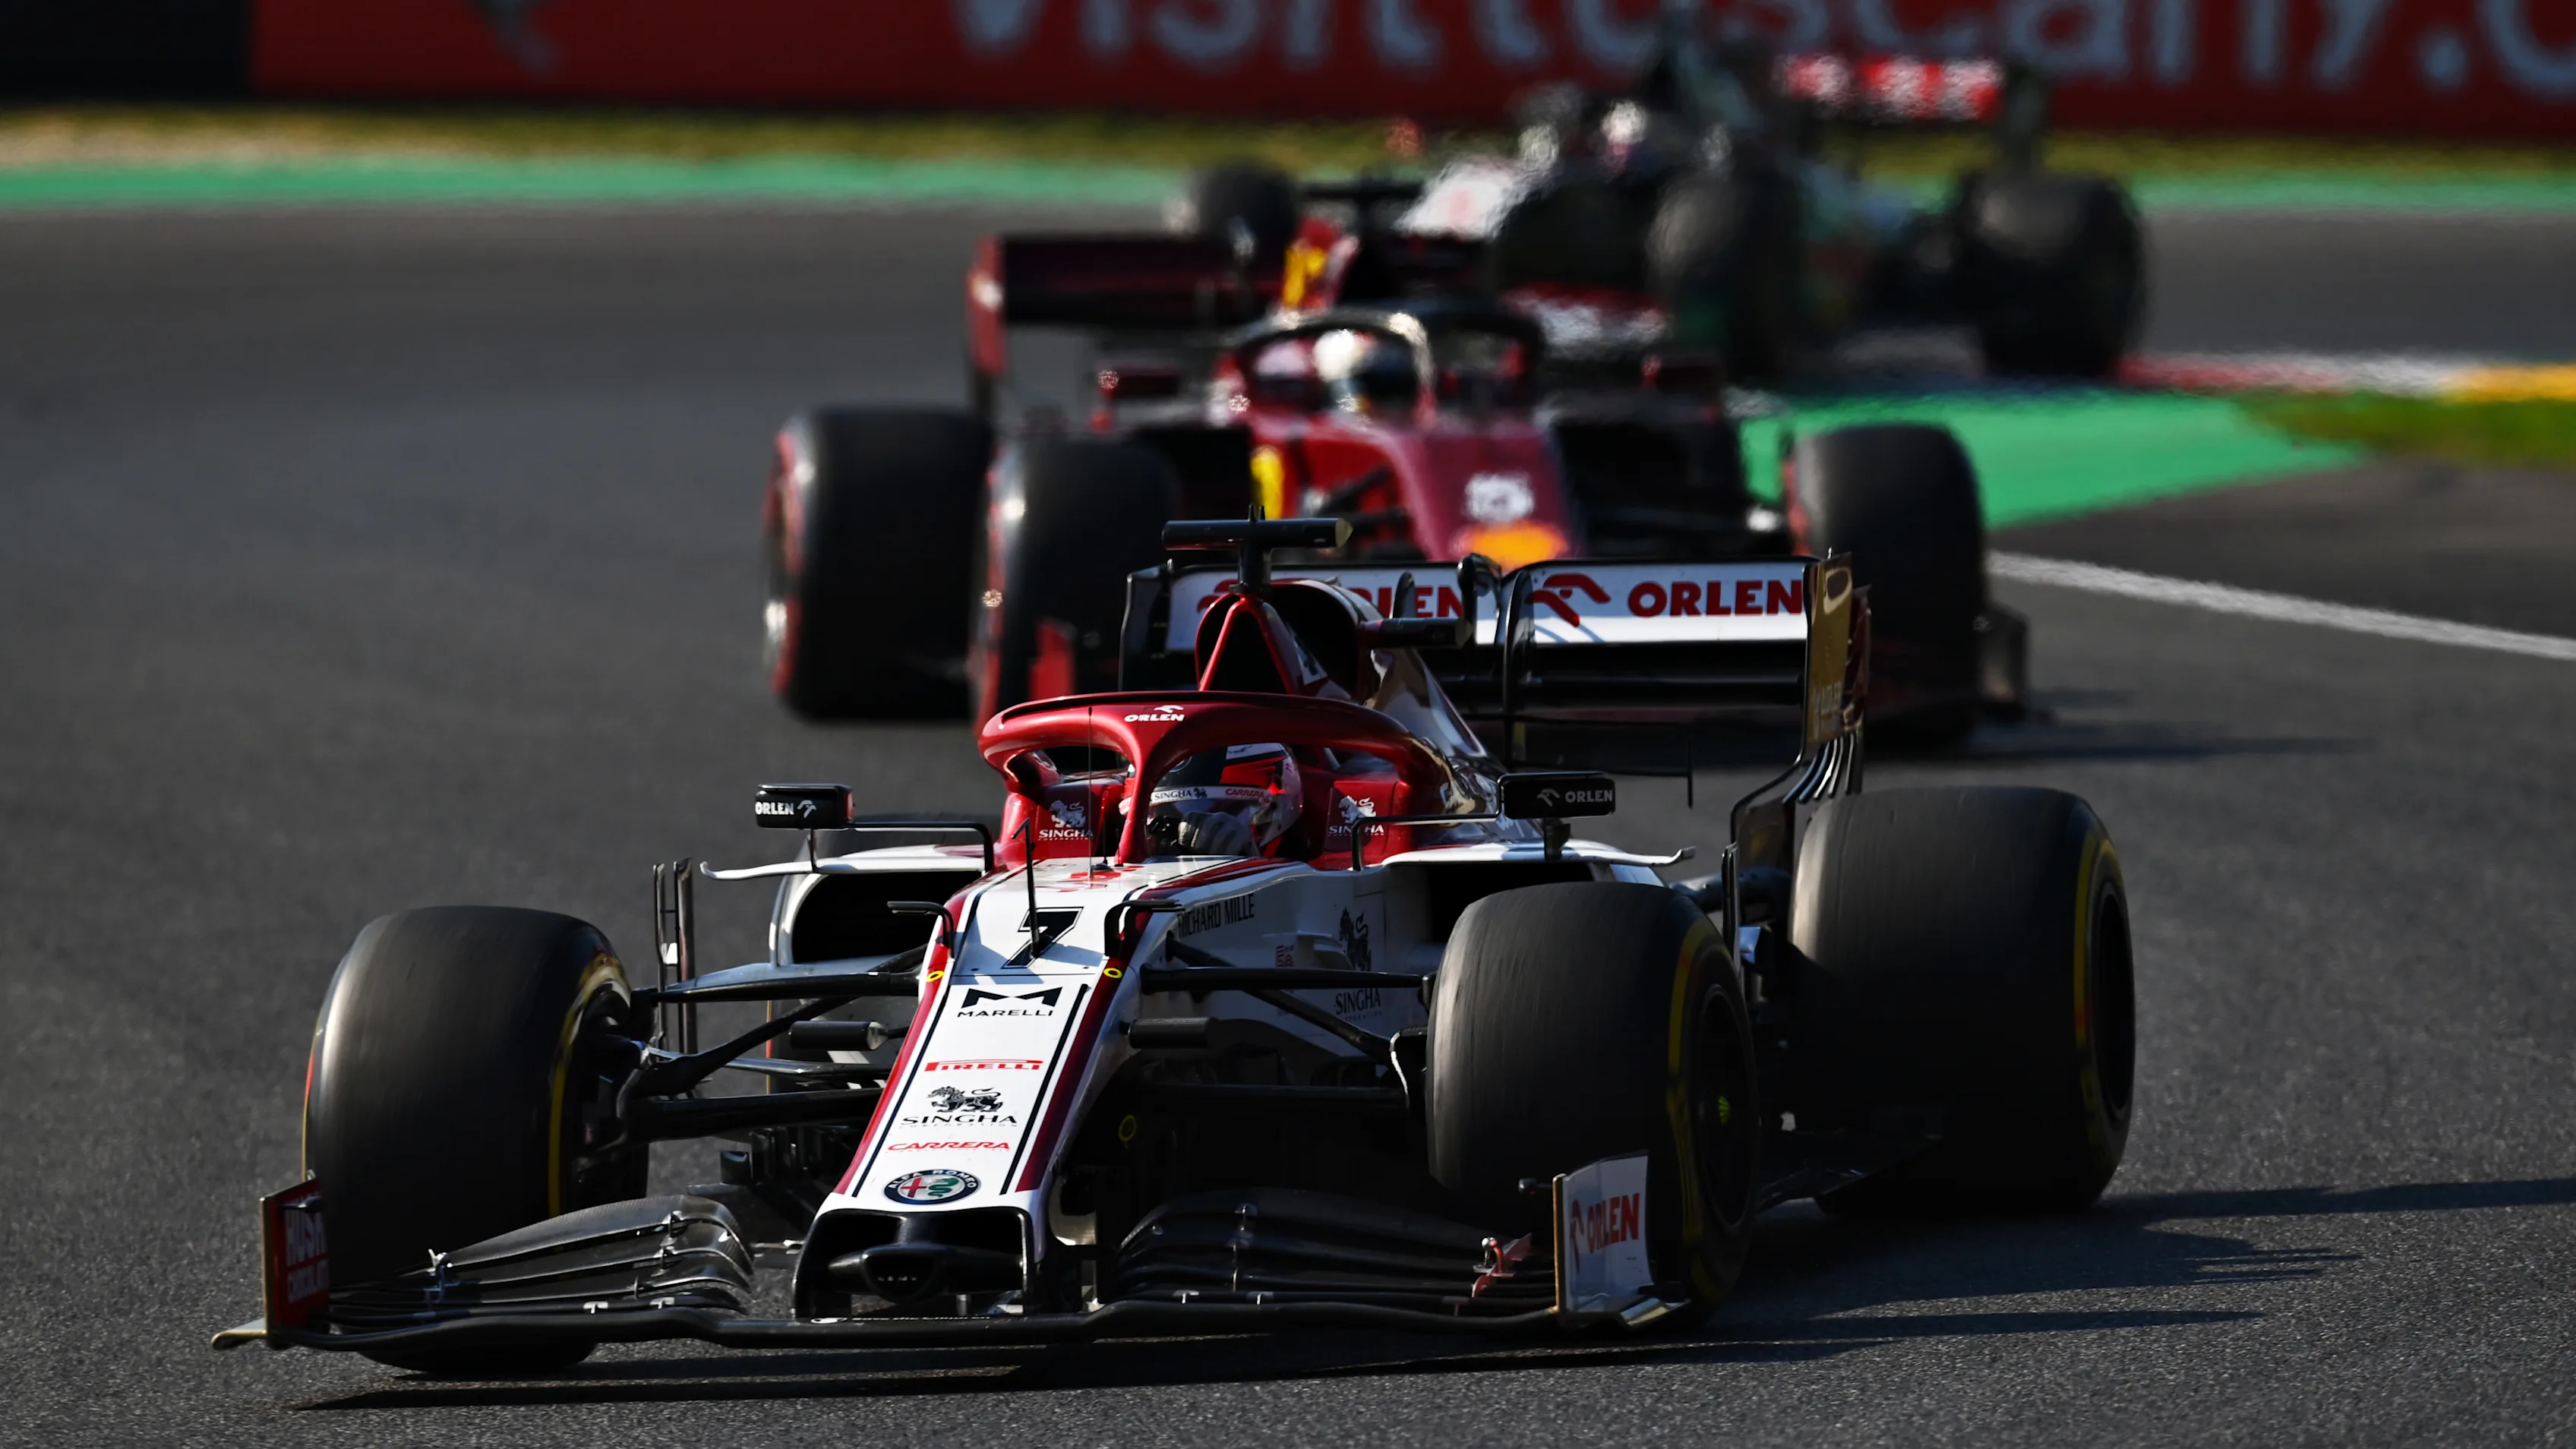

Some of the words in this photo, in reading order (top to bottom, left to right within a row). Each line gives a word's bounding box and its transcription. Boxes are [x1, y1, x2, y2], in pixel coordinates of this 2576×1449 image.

[1627, 579, 1802, 617] ORLEN
[1124, 714, 1185, 722] ORLEN
[1154, 790, 1191, 800] SINGHA
[1226, 788, 1264, 797] CARRERA
[1564, 790, 1613, 803] ORLEN
[755, 801, 794, 815] ORLEN
[1038, 829, 1094, 838] SINGHA
[1329, 824, 1384, 834] SINHA
[1224, 892, 1255, 926] MILLE
[1000, 906, 1084, 969] 7
[1335, 987, 1381, 1015] SINGHA
[957, 1009, 1053, 1018] MARELLI
[924, 1059, 1043, 1072] PIRELLI
[901, 1115, 1018, 1125] SINGHA
[888, 1141, 1010, 1151] CARRERA
[887, 1172, 923, 1189] ALFA
[932, 1170, 977, 1189] ROMEO
[1586, 1192, 1640, 1255] ORLEN
